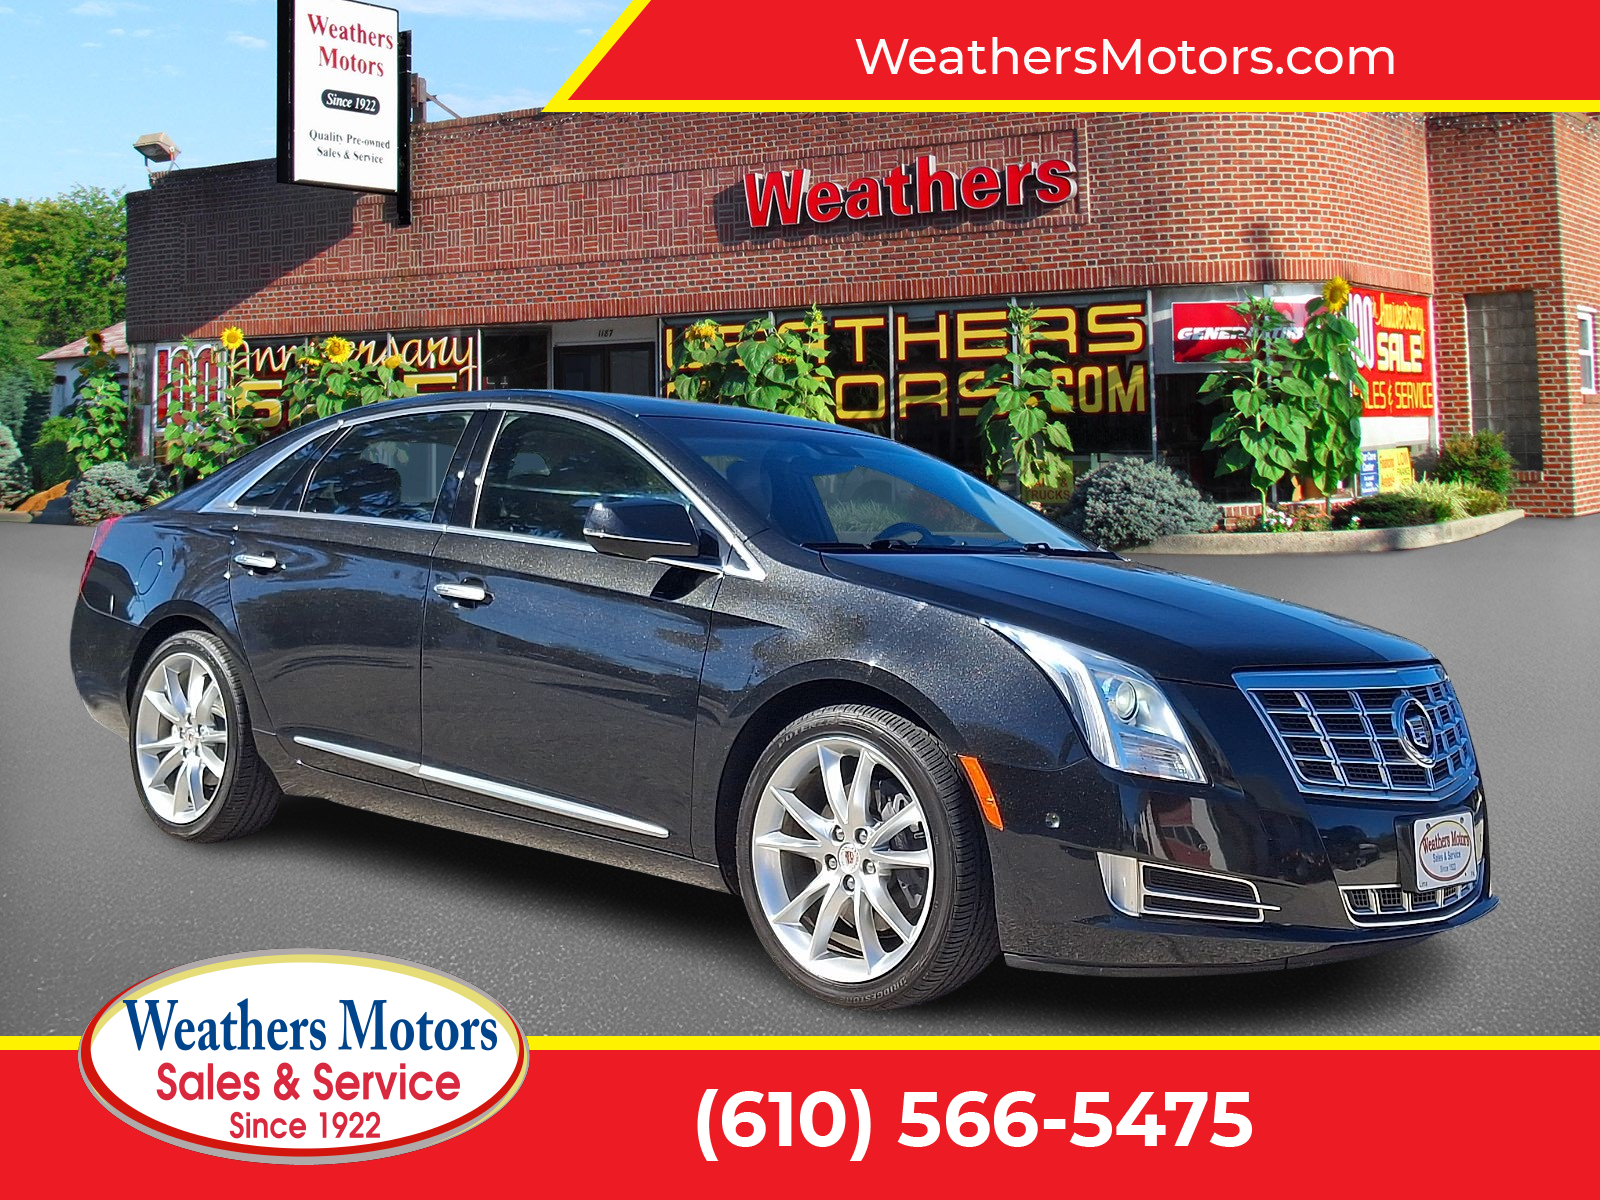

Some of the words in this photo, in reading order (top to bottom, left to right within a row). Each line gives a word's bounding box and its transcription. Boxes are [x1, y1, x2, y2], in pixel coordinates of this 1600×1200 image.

[307, 13, 394, 50] Weathers
[318, 45, 384, 77] Motors
[326, 92, 352, 109] Since
[354, 97, 377, 112] 1922
[309, 129, 343, 145] Quality
[346, 133, 391, 150] Pre-owned
[316, 146, 341, 159] Sales
[343, 150, 351, 160] &
[352, 151, 384, 164] Service
[743, 154, 1078, 228] Weathers
[597, 328, 614, 338] 1187
[1376, 331, 1423, 373] SALE
[1394, 381, 1434, 410] SERVICE
[1423, 833, 1450, 854] Weathers
[1451, 831, 1470, 847] Motors
